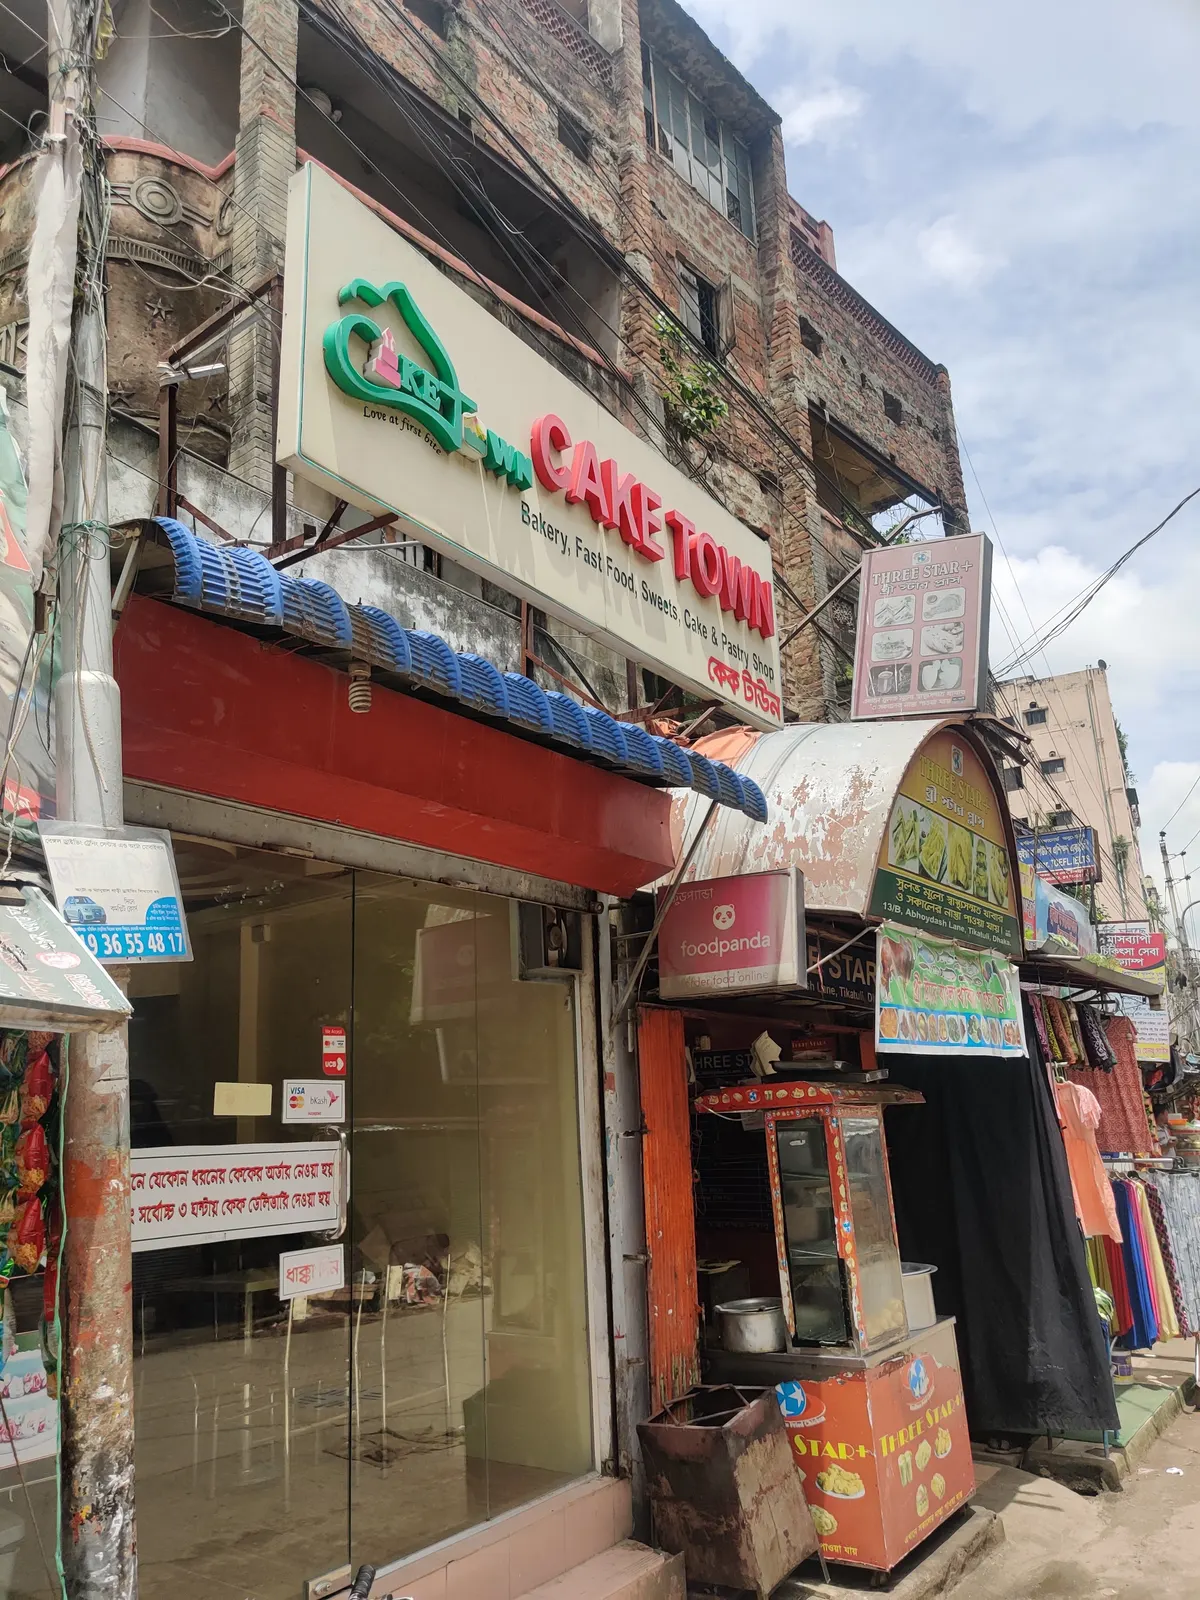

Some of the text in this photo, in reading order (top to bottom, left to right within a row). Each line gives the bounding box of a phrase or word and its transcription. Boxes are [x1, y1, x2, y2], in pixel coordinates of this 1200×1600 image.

[363, 406, 443, 456] Love at first bite
[530, 413, 775, 640] CAKE TOWN
[872, 566, 920, 586] THREE
[520, 500, 775, 683] Bakery, Fast Food, Sweets, Cake & Pastry Shop
[706, 656, 782, 718] কেক টাউন
[920, 754, 956, 796] THREE
[942, 795, 964, 818] স্টার
[895, 877, 921, 895] সুলভ
[895, 893, 904, 903] ও
[906, 894, 942, 914] সকালের
[882, 901, 904, 916] 13/B,
[905, 908, 947, 928] Abhoydash
[948, 921, 967, 935] Lane,
[101, 932, 122, 955] 36
[125, 932, 144, 954] 55
[147, 932, 165, 954] 48
[168, 932, 183, 953] 17
[680, 931, 771, 958] foodpanda
[1138, 947, 1160, 957] সেবা
[713, 973, 735, 986] food
[738, 970, 769, 982] online
[695, 1055, 731, 1069] HREE
[290, 1087, 306, 1095] VISA
[130, 1160, 334, 1191] নে যেকোন ধরনের কেকের অর্ডার নেওয়া হয়
[138, 1200, 176, 1224] সর্বোচ্চ
[178, 1202, 188, 1218] ৩
[222, 1197, 247, 1216] কেক
[291, 1192, 317, 1210] দেওয়া
[317, 1191, 331, 1207] হয়
[879, 1419, 926, 1457] THREE
